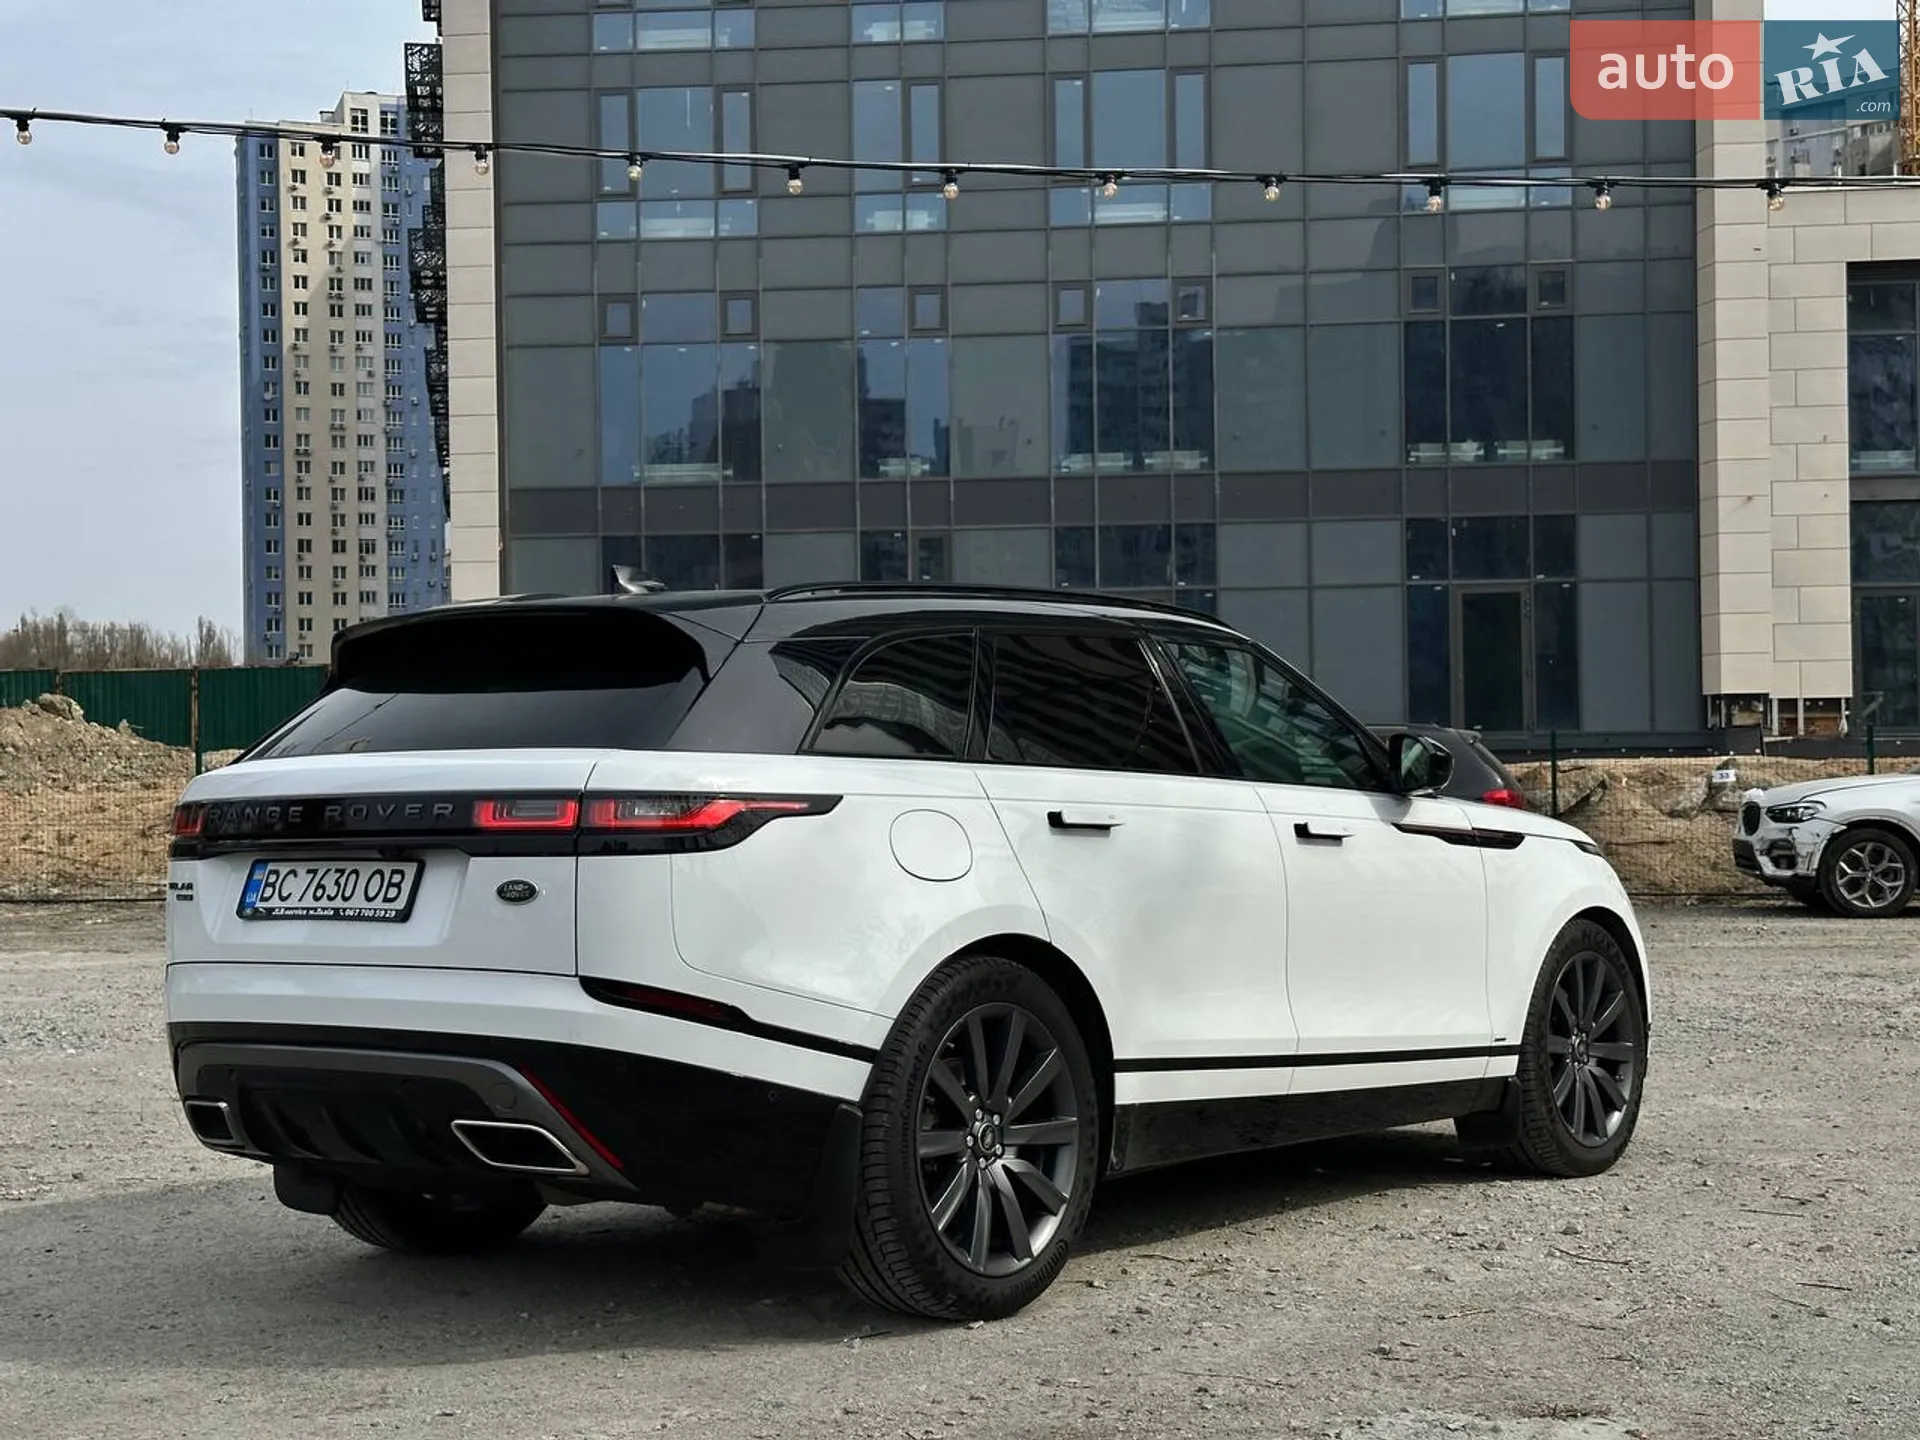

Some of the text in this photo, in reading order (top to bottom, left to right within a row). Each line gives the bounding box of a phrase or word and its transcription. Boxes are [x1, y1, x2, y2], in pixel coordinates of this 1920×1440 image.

[207, 802, 456, 825] RANGE ROVER
[258, 868, 406, 903] BC 7630 OB
[246, 892, 258, 903] UA
